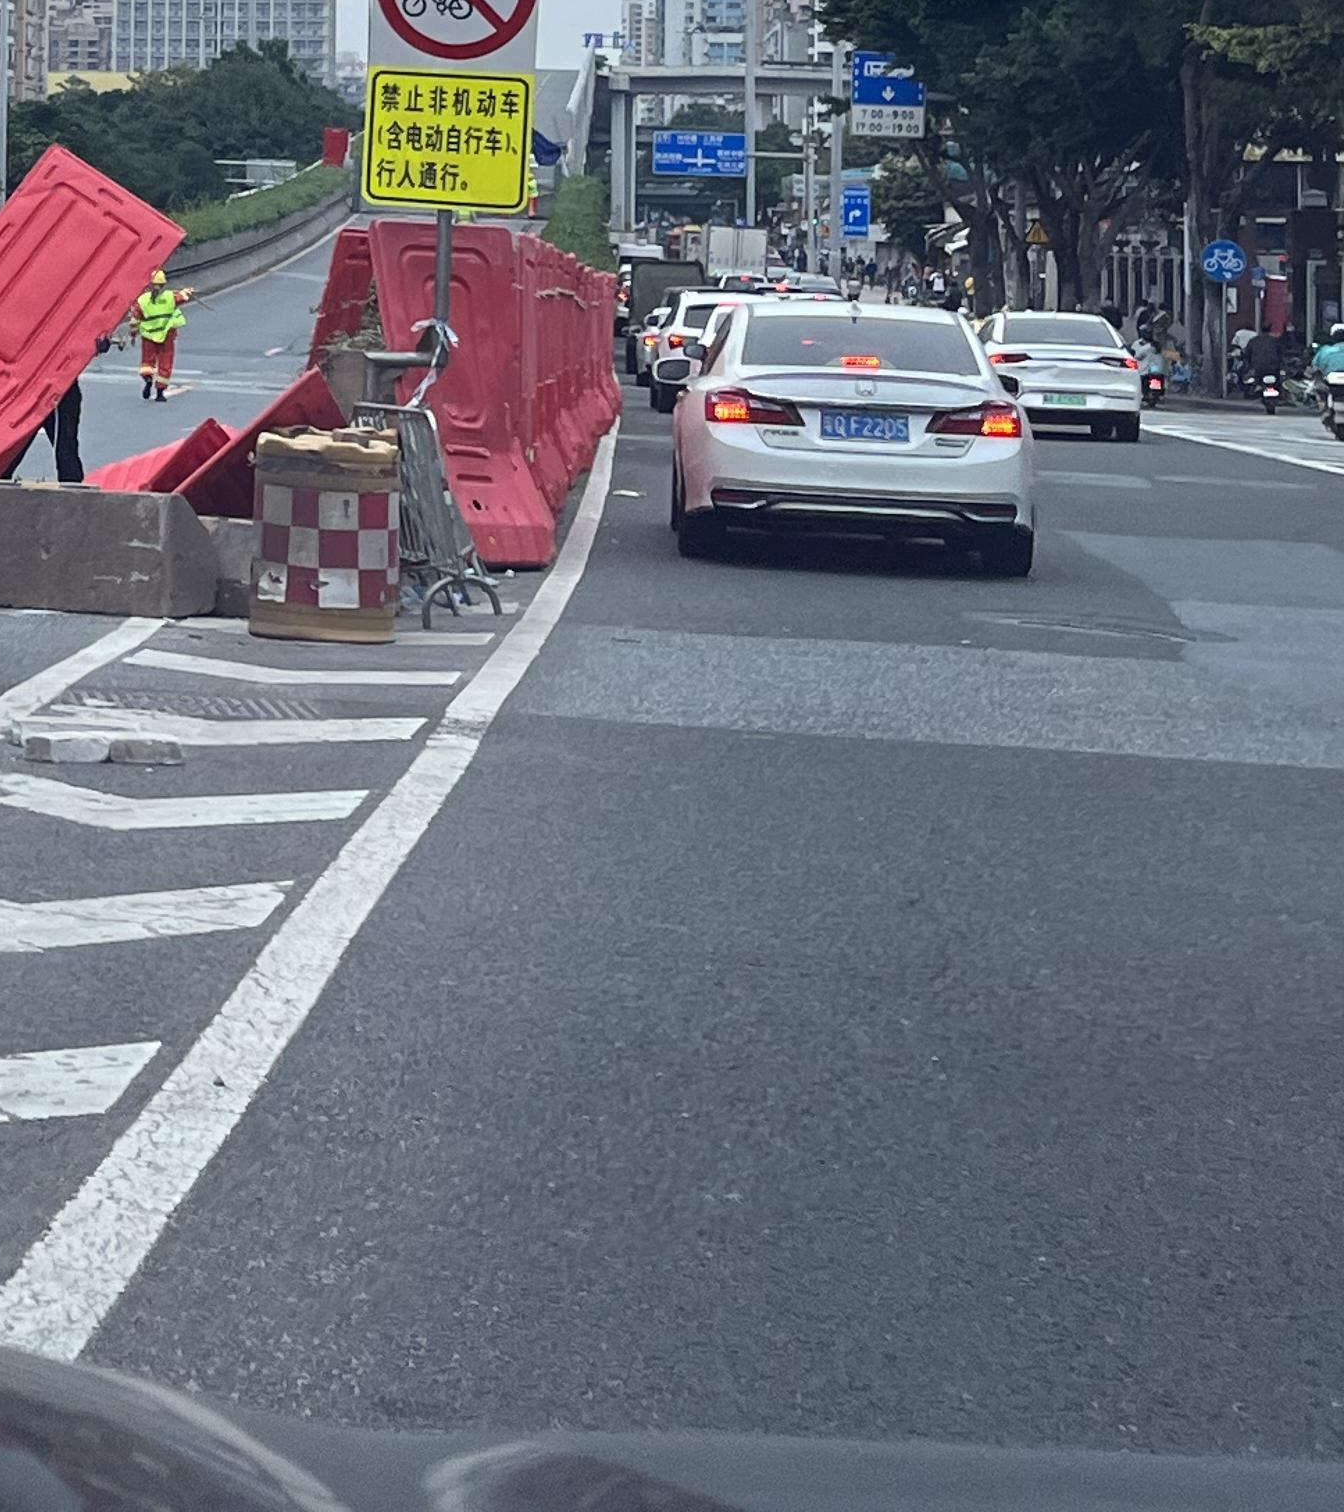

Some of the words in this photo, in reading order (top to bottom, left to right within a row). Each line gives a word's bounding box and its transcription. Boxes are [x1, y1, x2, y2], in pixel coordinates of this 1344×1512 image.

[380, 82, 520, 119] 禁止非机动车
